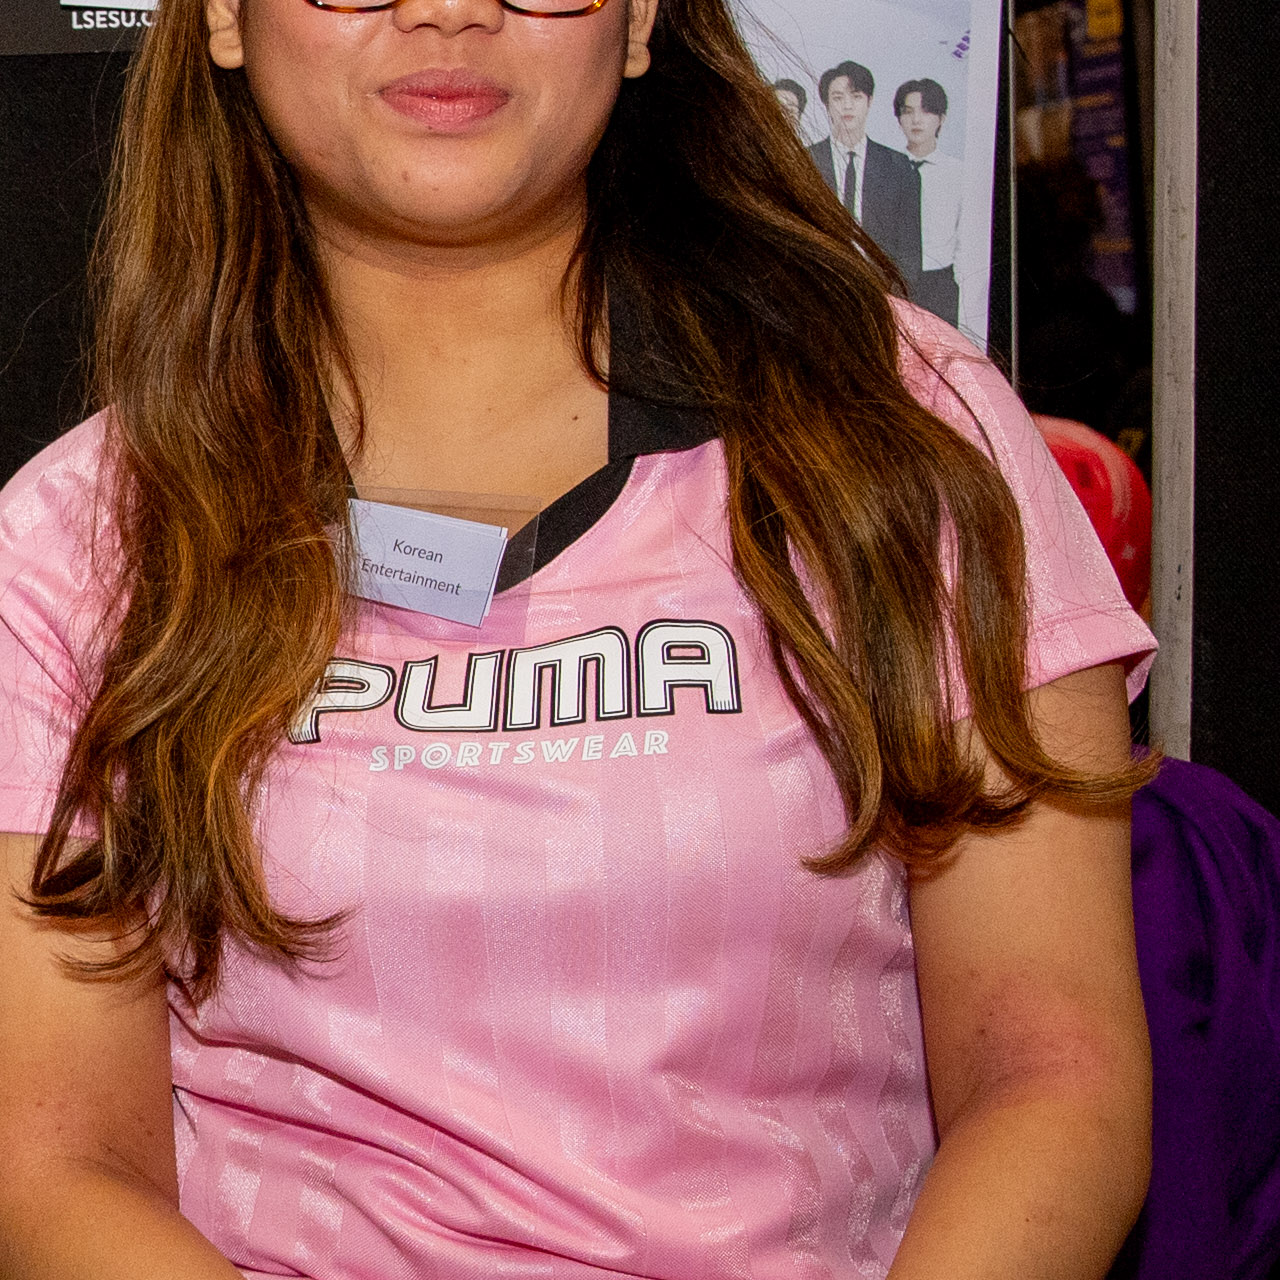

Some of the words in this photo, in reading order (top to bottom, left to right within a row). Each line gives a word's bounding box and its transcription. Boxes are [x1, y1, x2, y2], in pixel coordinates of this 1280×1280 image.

[393, 539, 444, 563] Korean
[361, 558, 461, 596] Entertainment
[287, 619, 742, 745] PUMA
[369, 730, 670, 772] SPORTSWEAR
